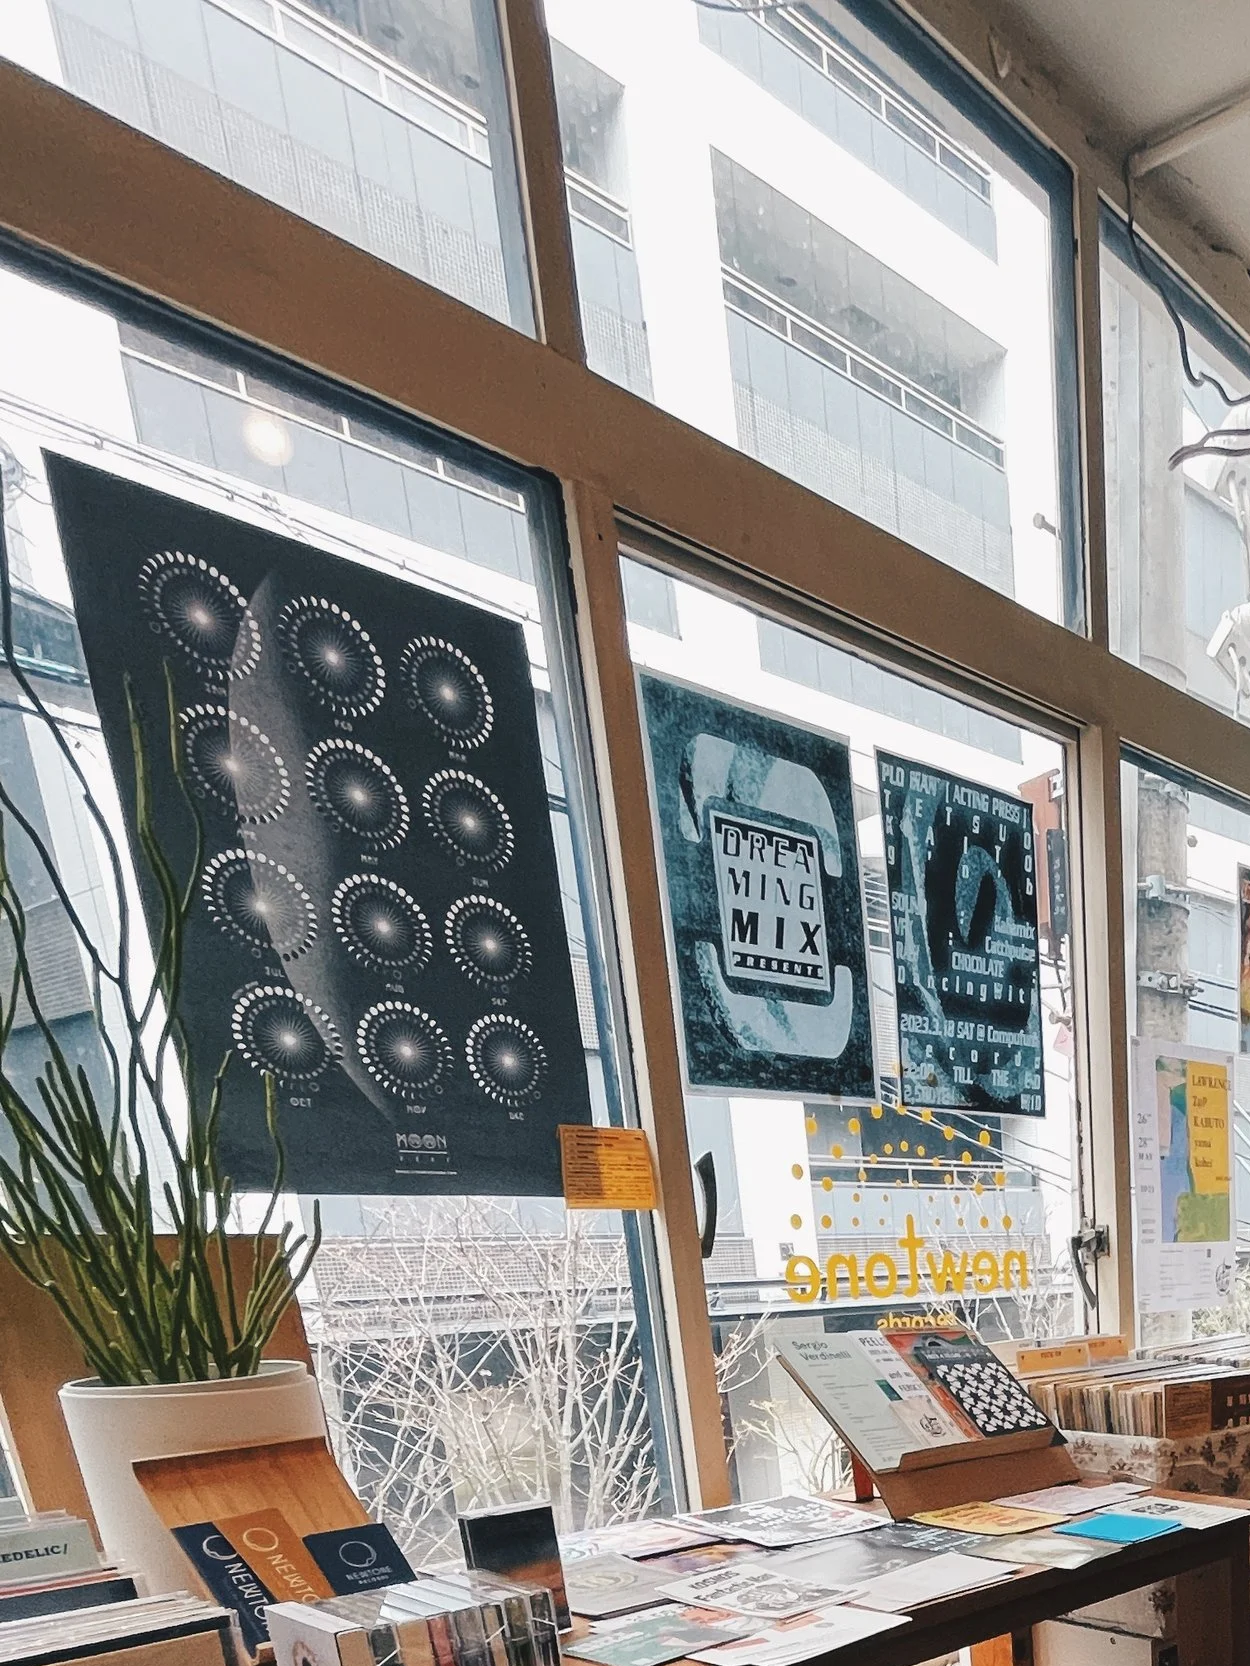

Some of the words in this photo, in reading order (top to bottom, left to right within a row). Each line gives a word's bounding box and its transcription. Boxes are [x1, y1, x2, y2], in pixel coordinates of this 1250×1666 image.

[726, 866, 816, 911] MING
[730, 909, 821, 956] MIX
[952, 951, 1004, 978] CHOCOLATE
[289, 1097, 311, 1107] OCT
[396, 1133, 447, 1149] MOON
[791, 1340, 828, 1351] Sergio
